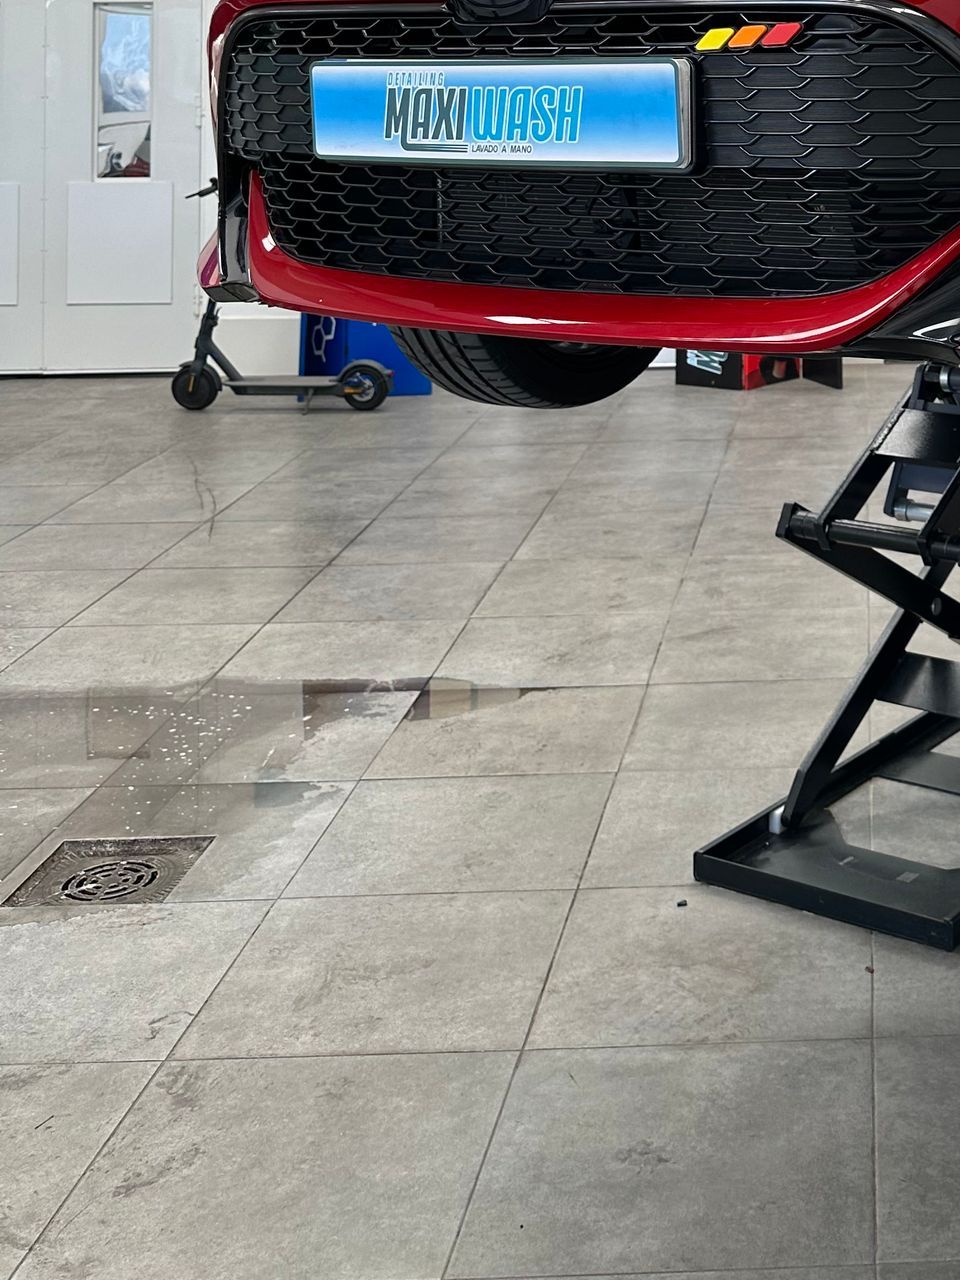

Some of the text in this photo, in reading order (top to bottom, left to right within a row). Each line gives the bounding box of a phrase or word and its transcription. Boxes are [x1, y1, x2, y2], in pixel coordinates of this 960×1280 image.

[387, 72, 445, 86] DETAILING
[385, 86, 583, 143] MAXI WASH
[472, 145, 533, 154] LAVADO A MANO
